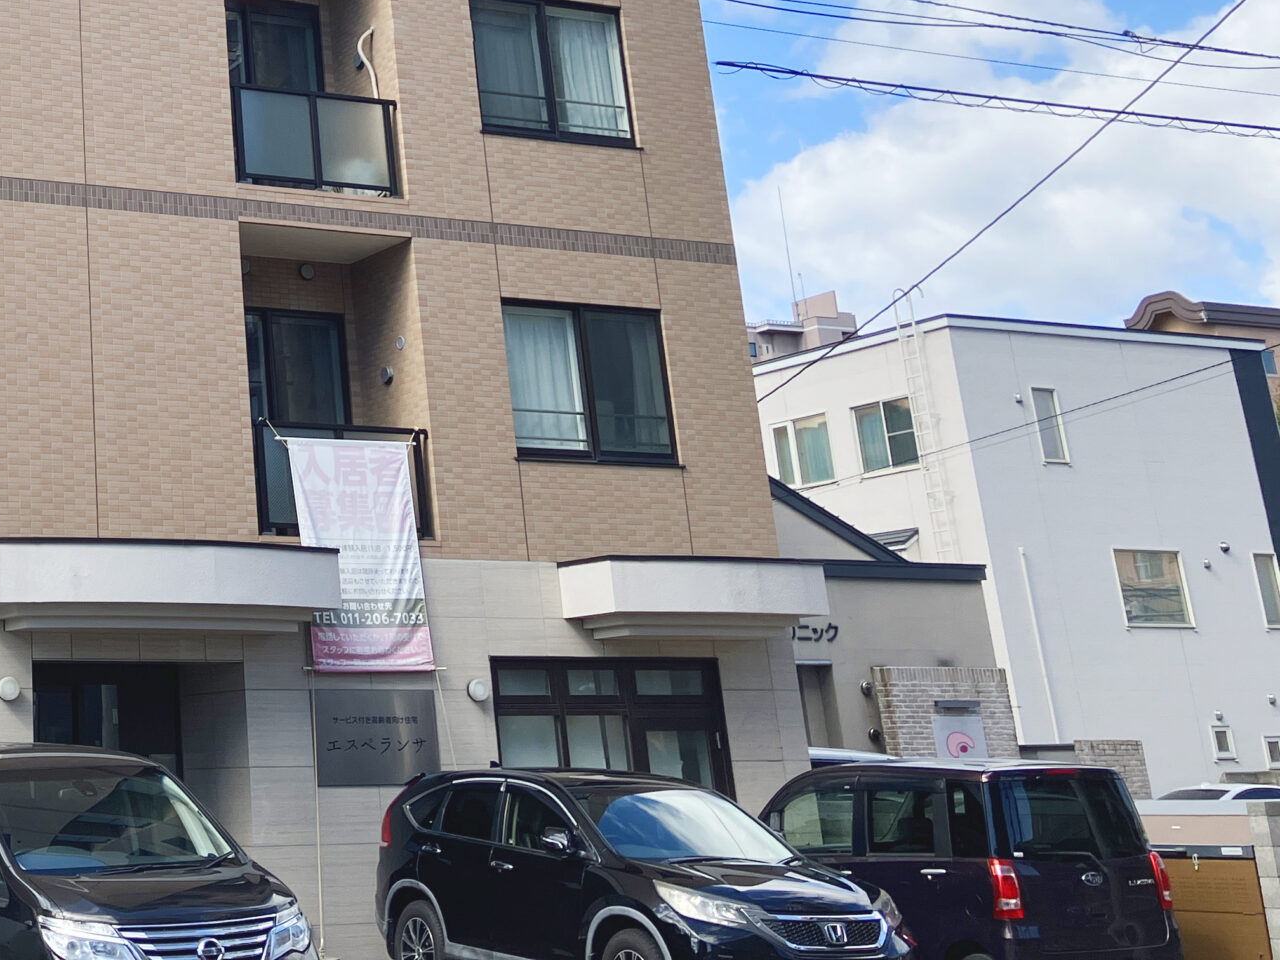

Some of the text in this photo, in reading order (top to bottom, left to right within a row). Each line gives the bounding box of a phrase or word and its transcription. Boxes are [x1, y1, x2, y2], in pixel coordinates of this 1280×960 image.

[313, 611, 425, 625] TEL 011-206-7033
[326, 737, 427, 756] エスペランサ
